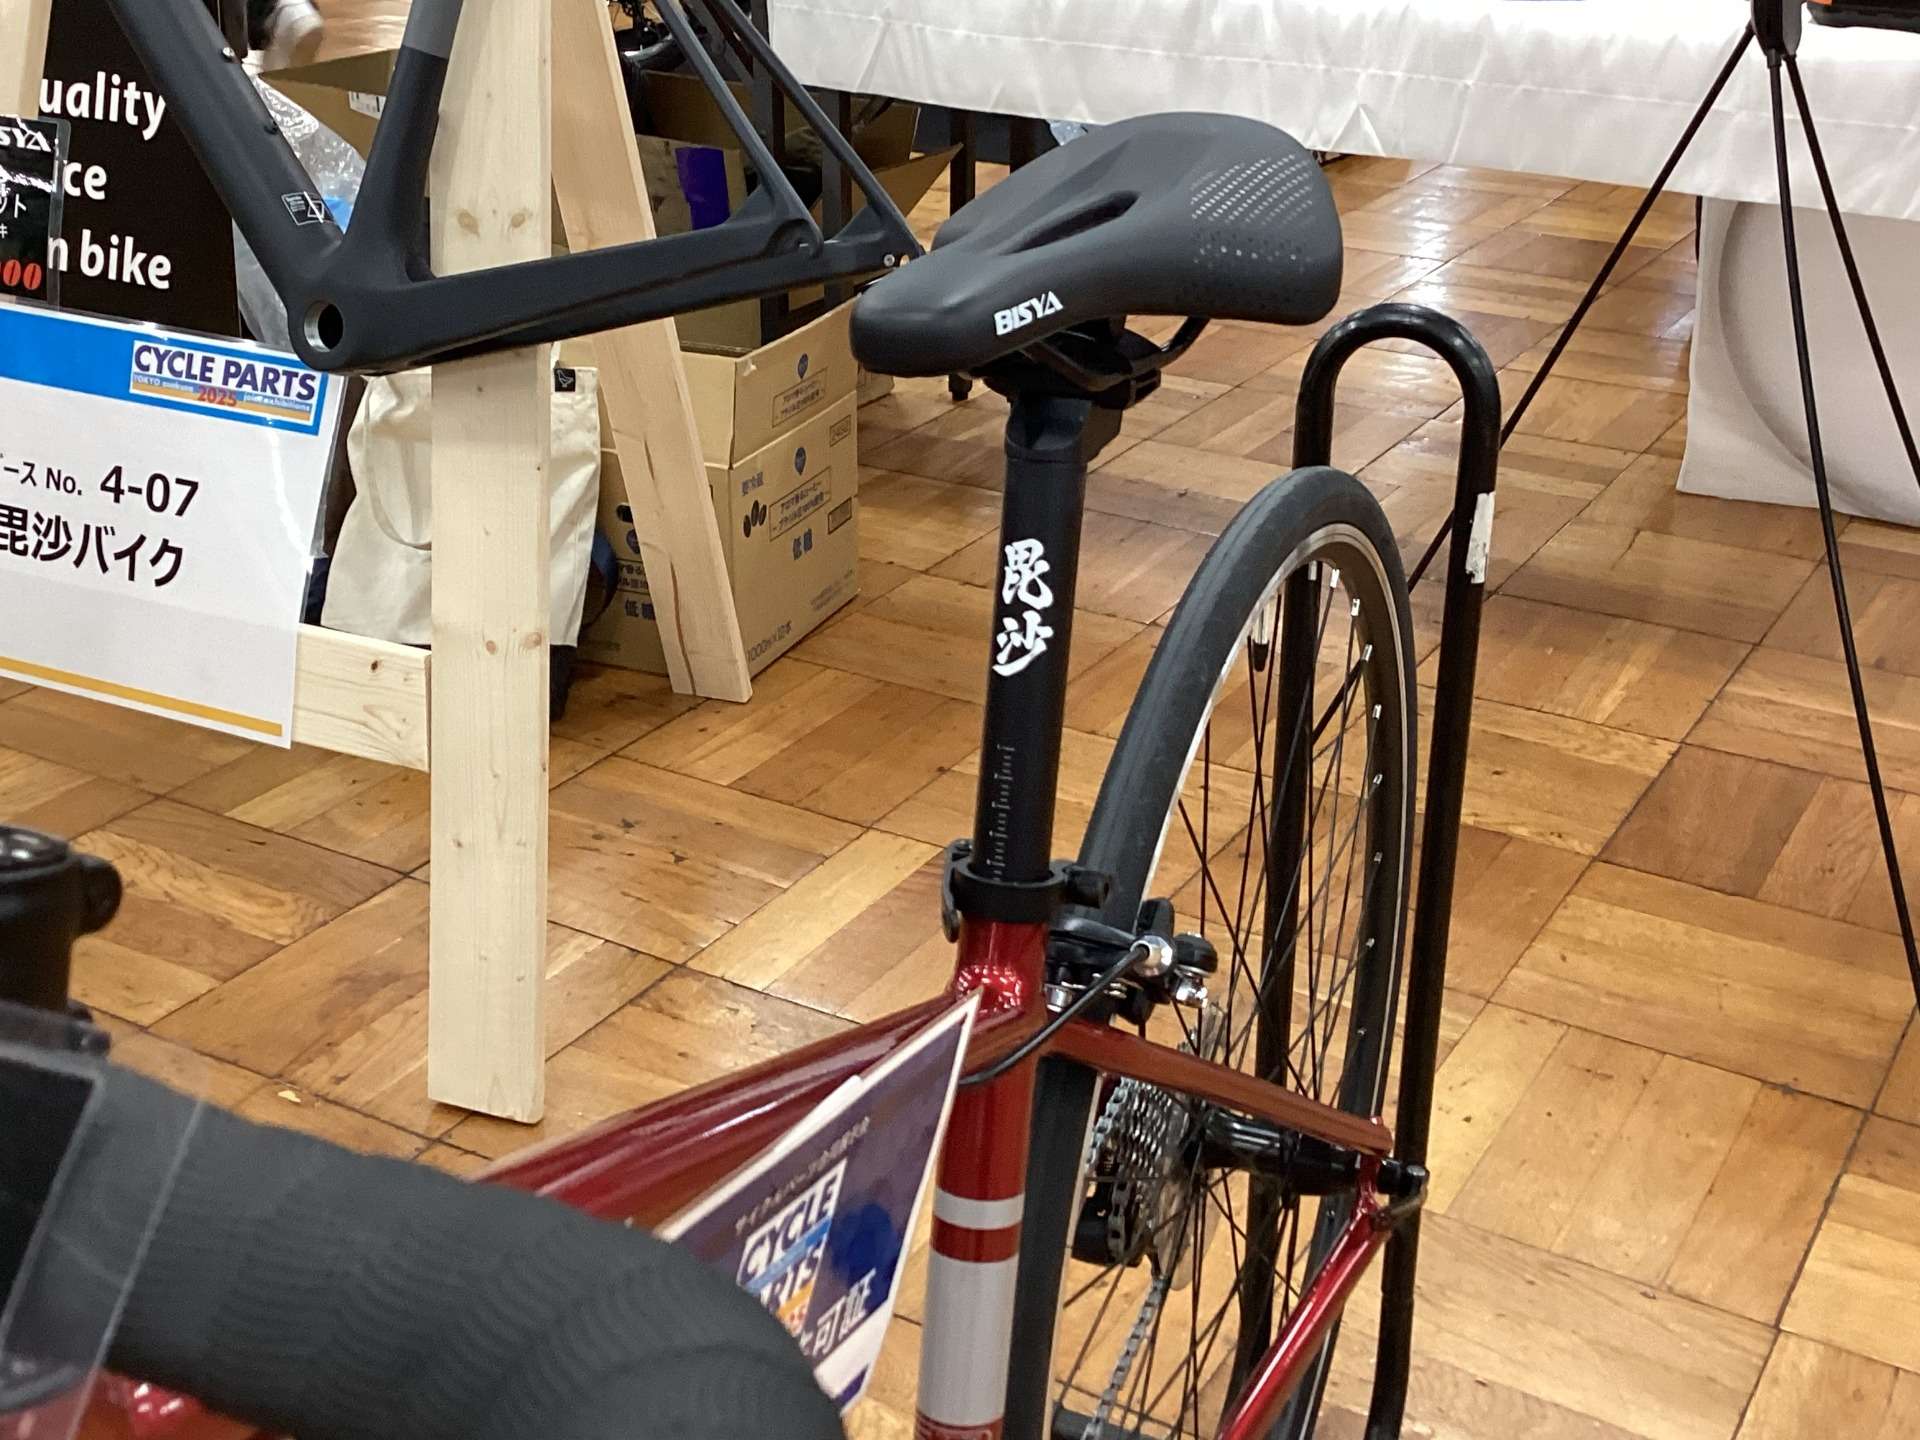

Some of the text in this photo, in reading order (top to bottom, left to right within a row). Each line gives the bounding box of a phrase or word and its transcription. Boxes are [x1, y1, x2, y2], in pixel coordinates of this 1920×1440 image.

[63, 160, 107, 200] ce
[0, 259, 42, 290] 00
[80, 229, 172, 289] bike
[993, 290, 1064, 336] BISYA
[134, 344, 316, 401] CYCLE PARTS
[198, 386, 238, 408] 2025
[46, 467, 82, 496] No.
[100, 465, 199, 517] 4-07
[992, 538, 1054, 677] 毘沙
